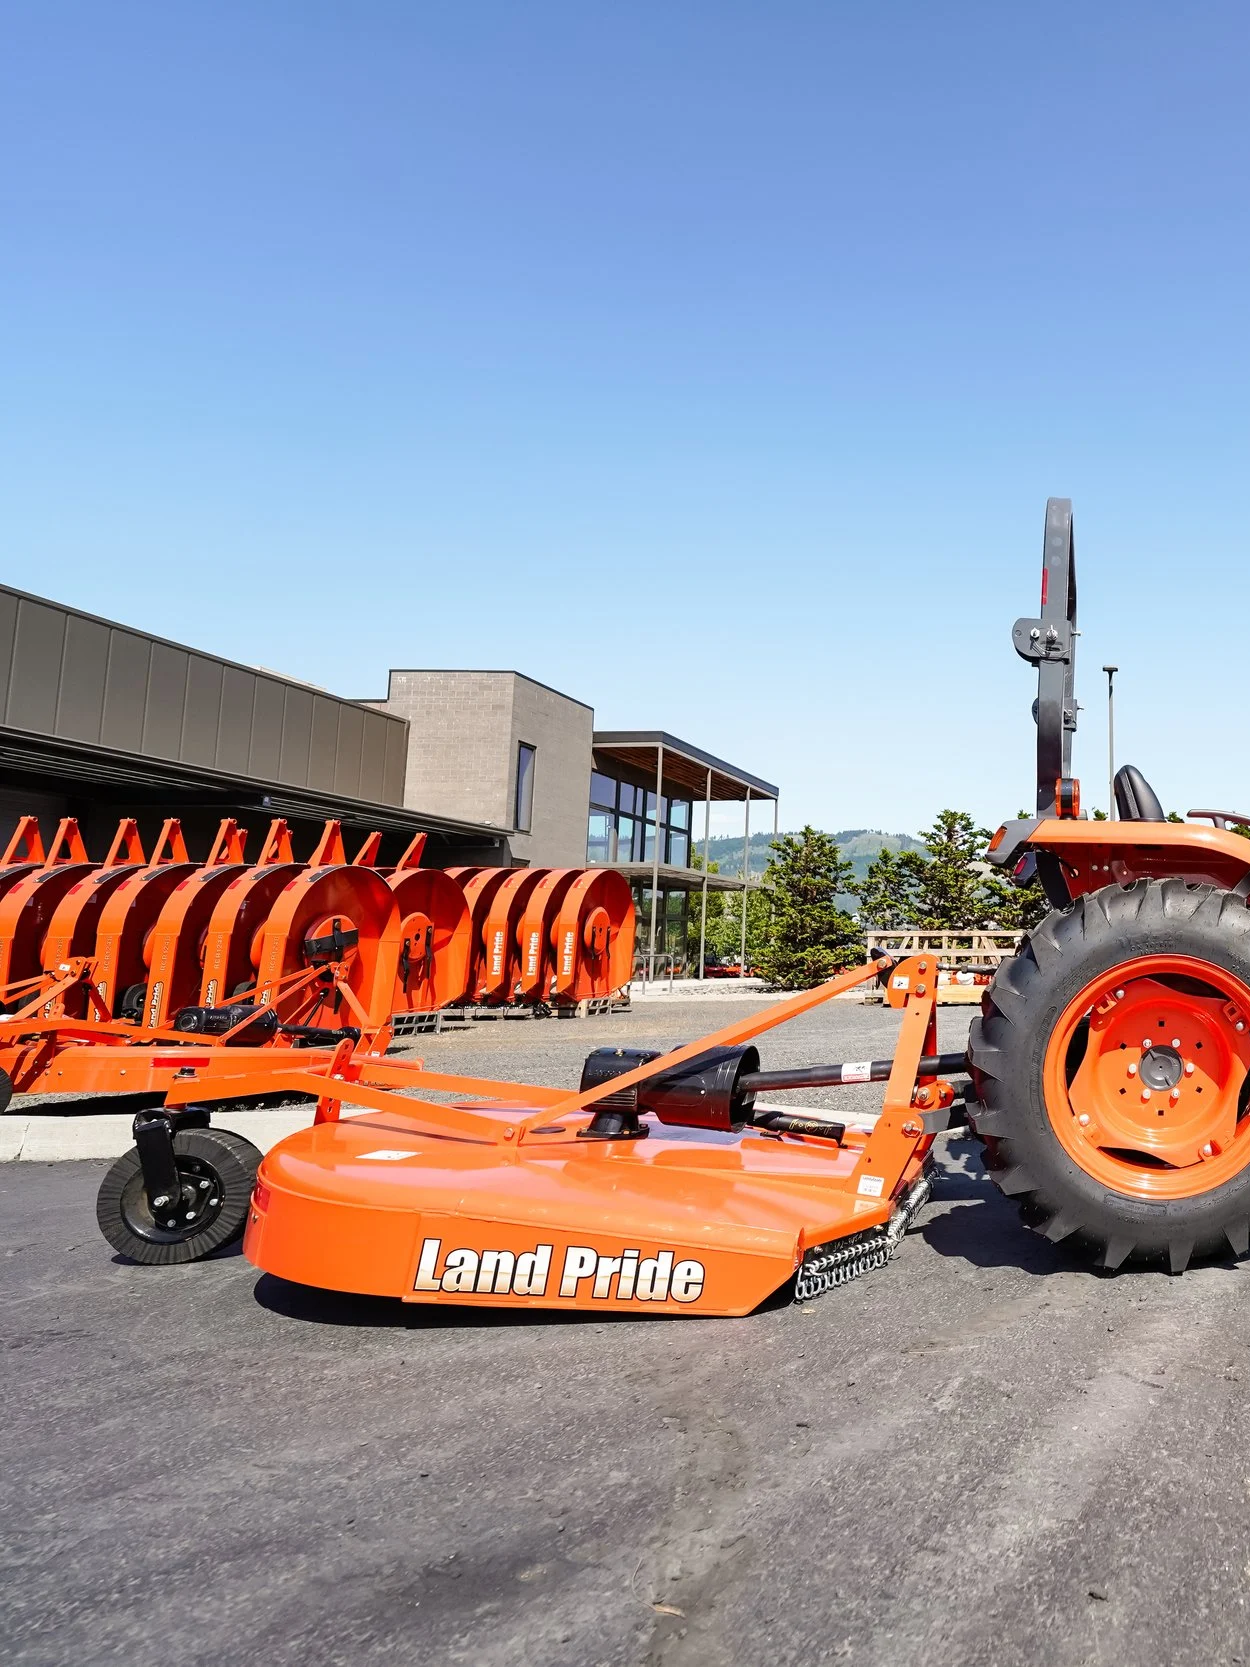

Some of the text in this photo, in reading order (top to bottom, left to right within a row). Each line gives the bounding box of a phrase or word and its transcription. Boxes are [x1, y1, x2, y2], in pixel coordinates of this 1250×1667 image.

[491, 931, 504, 976] Land Pride
[526, 931, 539, 976] Land Pride
[561, 931, 574, 976] Land Pride
[151, 981, 163, 1006] Pride
[413, 1237, 705, 1302] Land Pride
